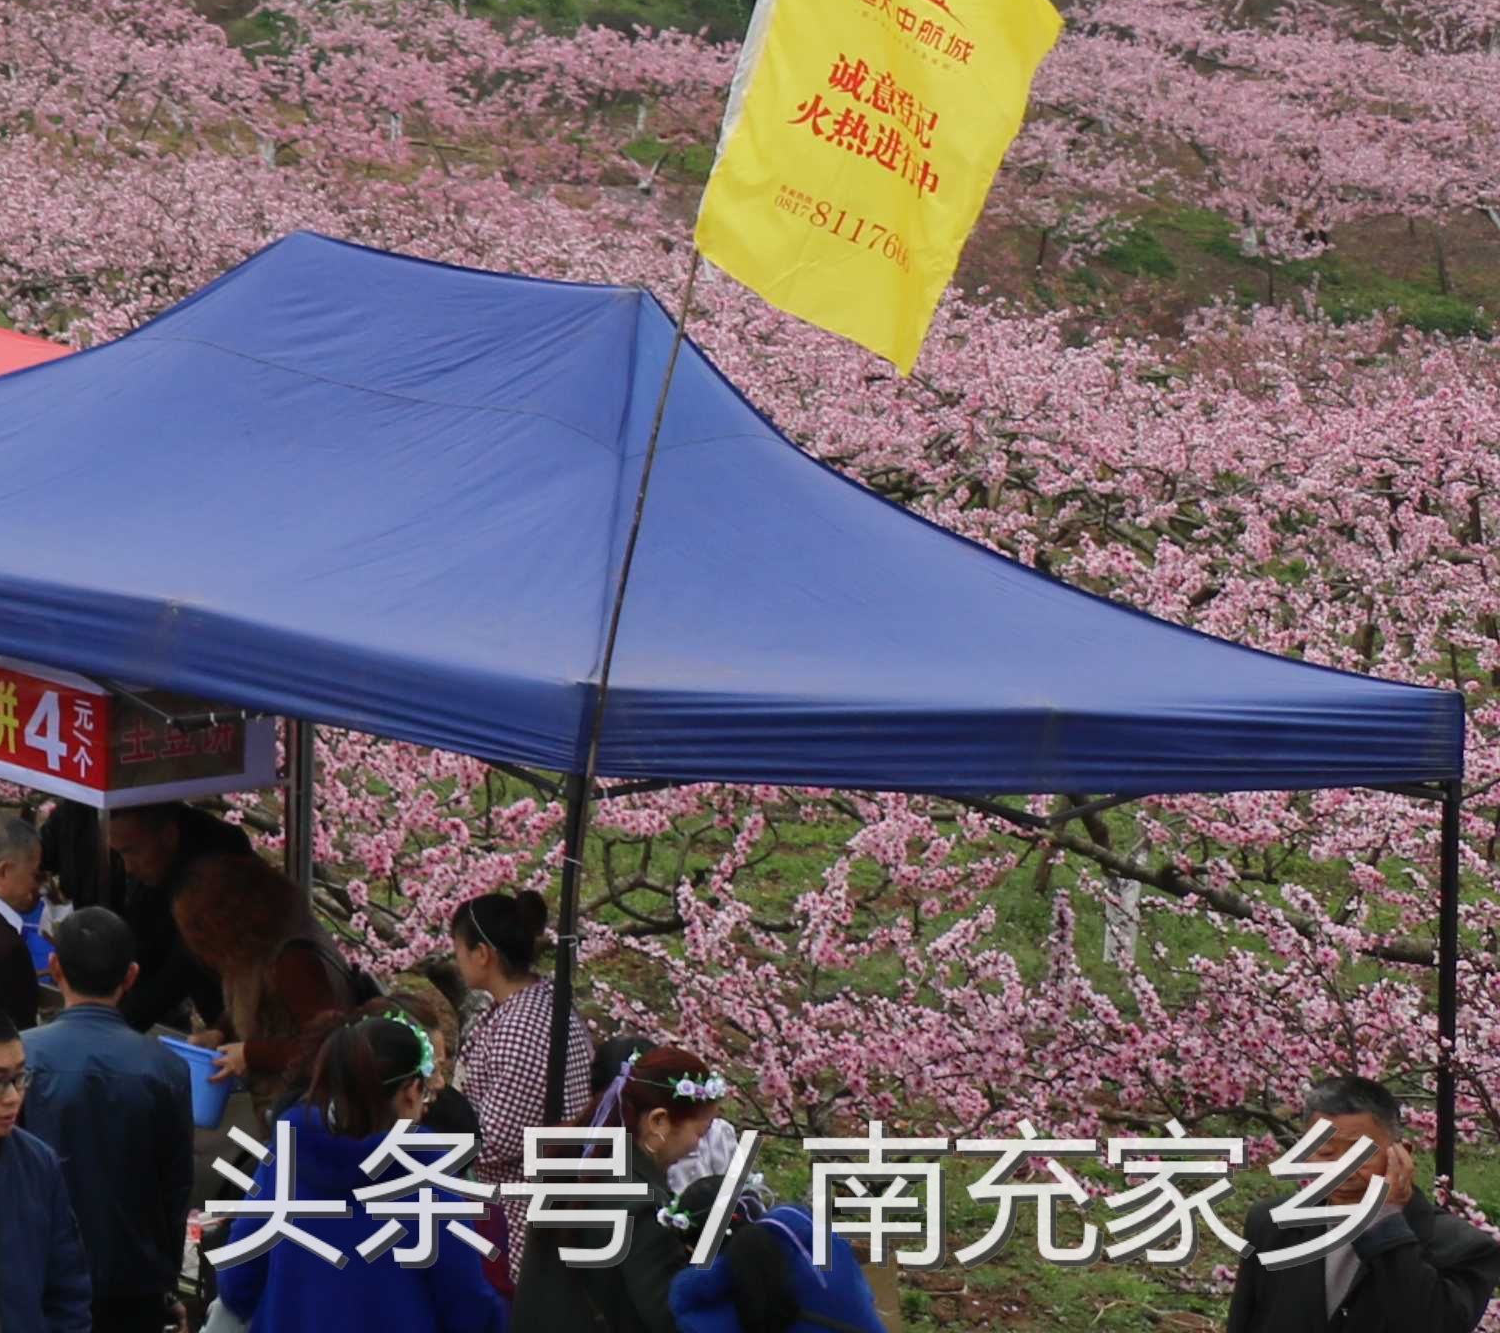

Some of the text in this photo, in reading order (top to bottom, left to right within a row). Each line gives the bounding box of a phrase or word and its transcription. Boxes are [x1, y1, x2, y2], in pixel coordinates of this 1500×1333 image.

[787, 93, 940, 199] 火热进行中
[828, 52, 940, 150] 诚意登记
[23, 690, 68, 772] 4
[72, 699, 94, 778] 元/个
